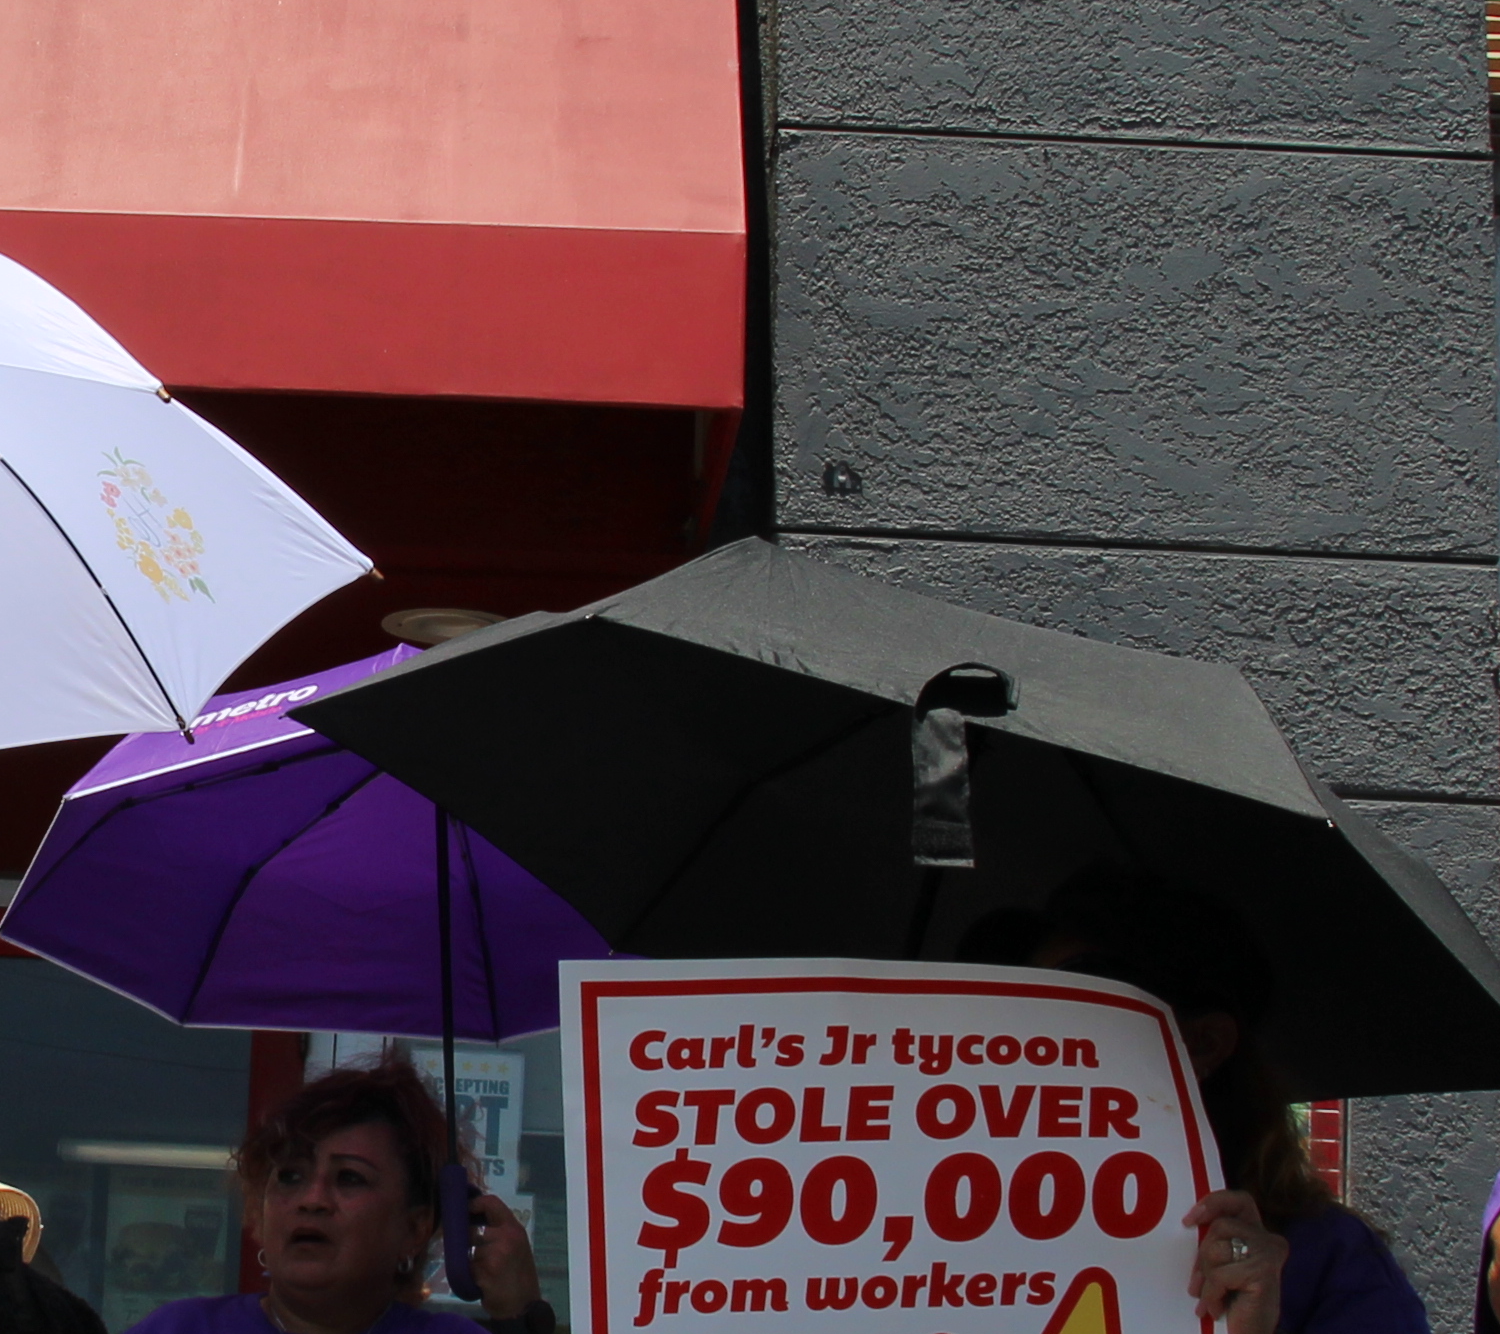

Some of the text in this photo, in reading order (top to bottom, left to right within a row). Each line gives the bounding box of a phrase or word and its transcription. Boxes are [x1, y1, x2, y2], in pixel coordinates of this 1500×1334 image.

[189, 685, 318, 728] metro
[628, 1024, 1100, 1075] Carl's Jr tycoon
[632, 1083, 1140, 1149] STOLE OVER
[637, 1148, 1169, 1270] $90,000
[633, 1262, 1057, 1328] from workers
